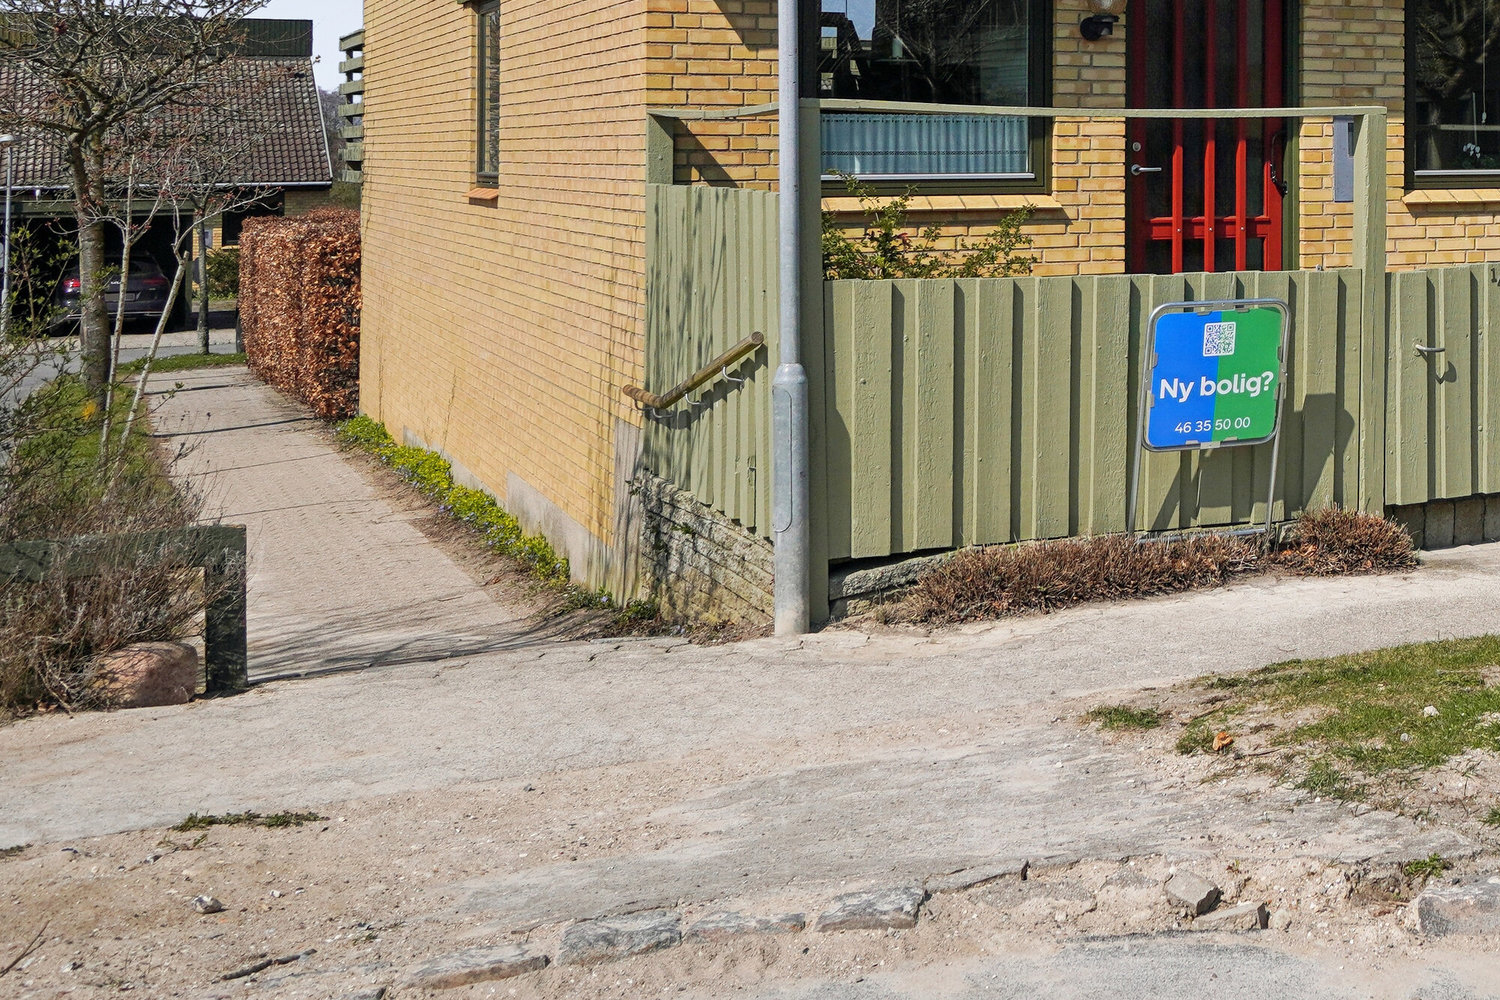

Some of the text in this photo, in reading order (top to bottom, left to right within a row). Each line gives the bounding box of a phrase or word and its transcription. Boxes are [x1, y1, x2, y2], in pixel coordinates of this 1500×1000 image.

[1159, 371, 1274, 403] Ny bolig?
[1175, 417, 1250, 433] 46 35 50 00
